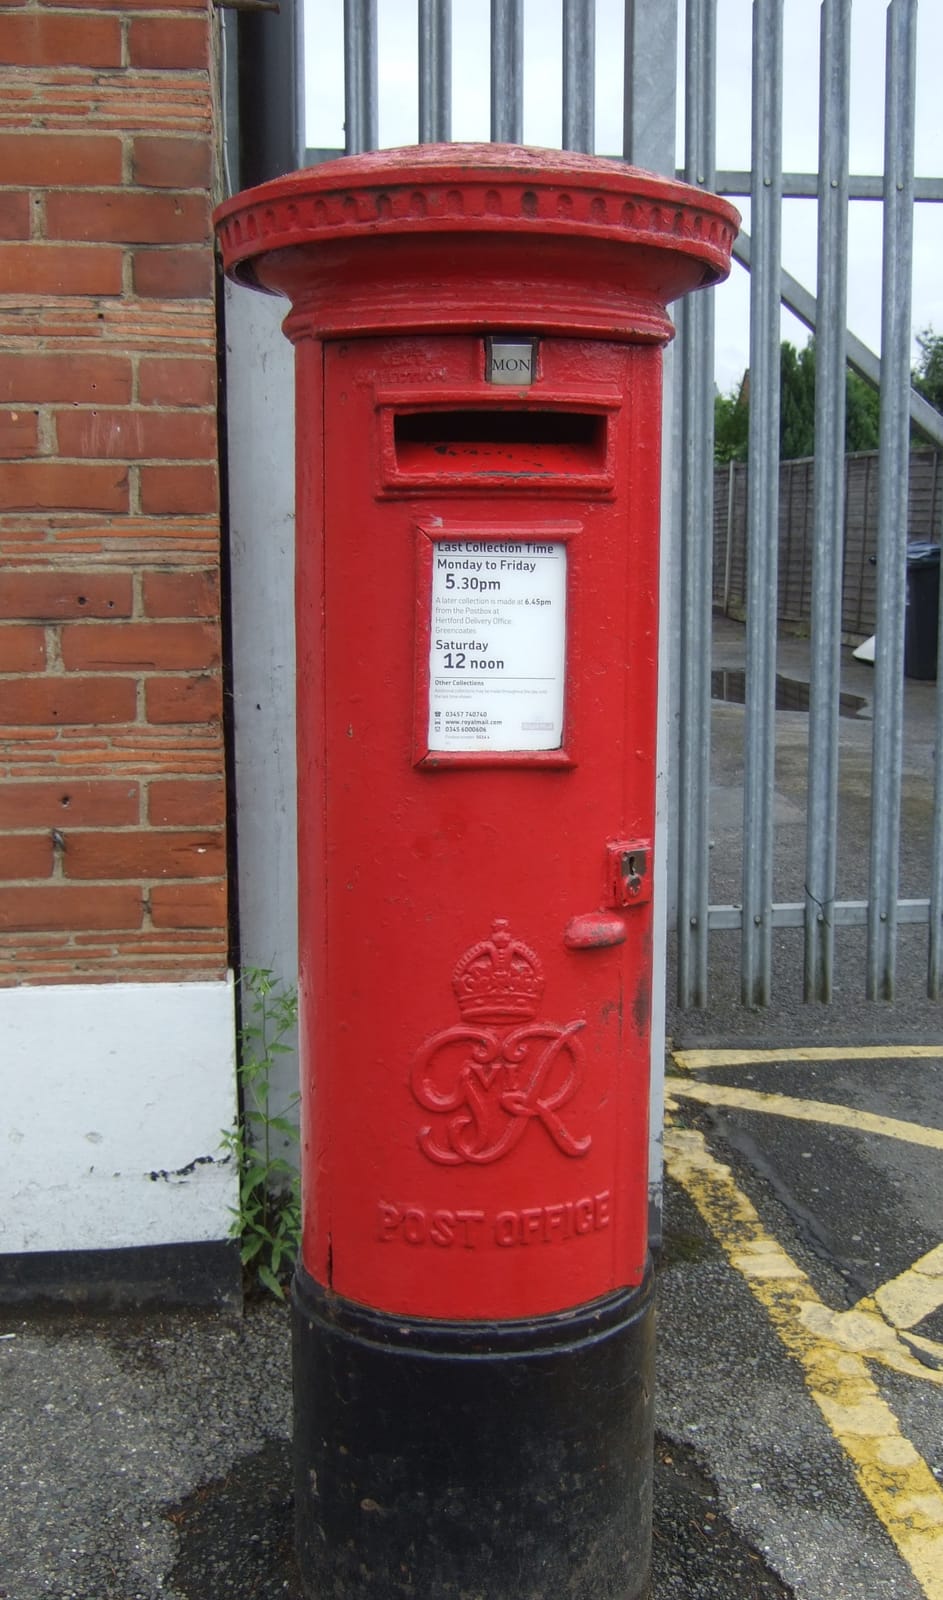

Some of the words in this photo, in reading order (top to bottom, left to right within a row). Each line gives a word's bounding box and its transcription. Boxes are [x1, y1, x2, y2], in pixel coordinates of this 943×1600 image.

[492, 359, 532, 371] MON
[437, 542, 462, 552] Last
[466, 542, 522, 553] Collection
[525, 543, 554, 554] Time
[437, 559, 482, 572] Monday
[486, 561, 497, 570] to
[500, 560, 536, 573] Friday
[445, 573, 501, 592] 5.30pm
[458, 597, 489, 605] collection
[515, 598, 523, 606] at
[524, 598, 552, 607] 6.45pm
[465, 607, 492, 615] Postbox
[435, 617, 464, 625] Hertford
[465, 617, 492, 626] Delivery
[435, 640, 489, 652] Saturday
[443, 653, 466, 669] 12
[470, 660, 504, 669] noon
[377, 1200, 485, 1249] POST
[495, 1190, 610, 1248] OFFICE
